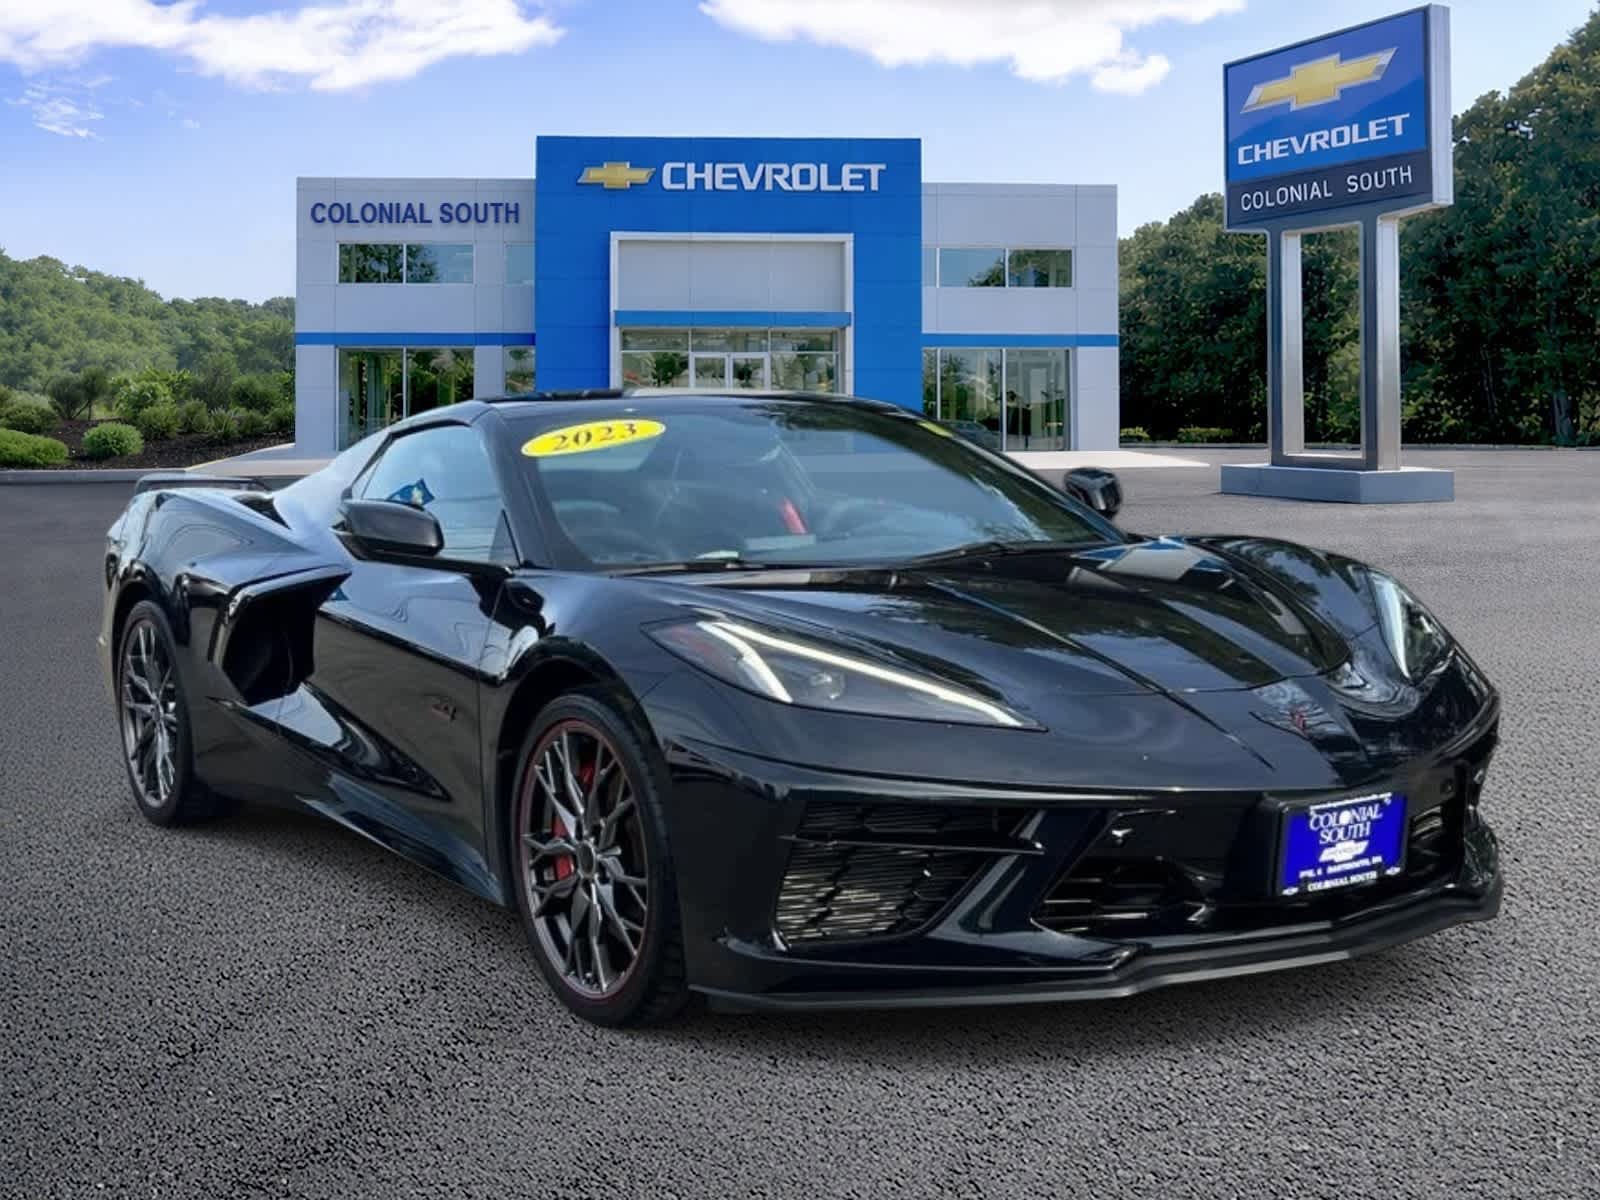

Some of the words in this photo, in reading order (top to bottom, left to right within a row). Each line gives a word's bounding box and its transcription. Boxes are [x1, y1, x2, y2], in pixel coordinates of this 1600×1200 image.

[1237, 112, 1410, 165] CHEVROLET
[661, 161, 887, 192] CHEVROLET
[1240, 180, 1333, 211] COLONIAL
[1346, 165, 1413, 193] SOUTH
[310, 202, 433, 225] COLONIAL
[439, 202, 520, 225] SOUTH
[552, 422, 637, 451] 2023
[1309, 803, 1383, 831] COLONIAL
[1319, 821, 1371, 844] SOUTH
